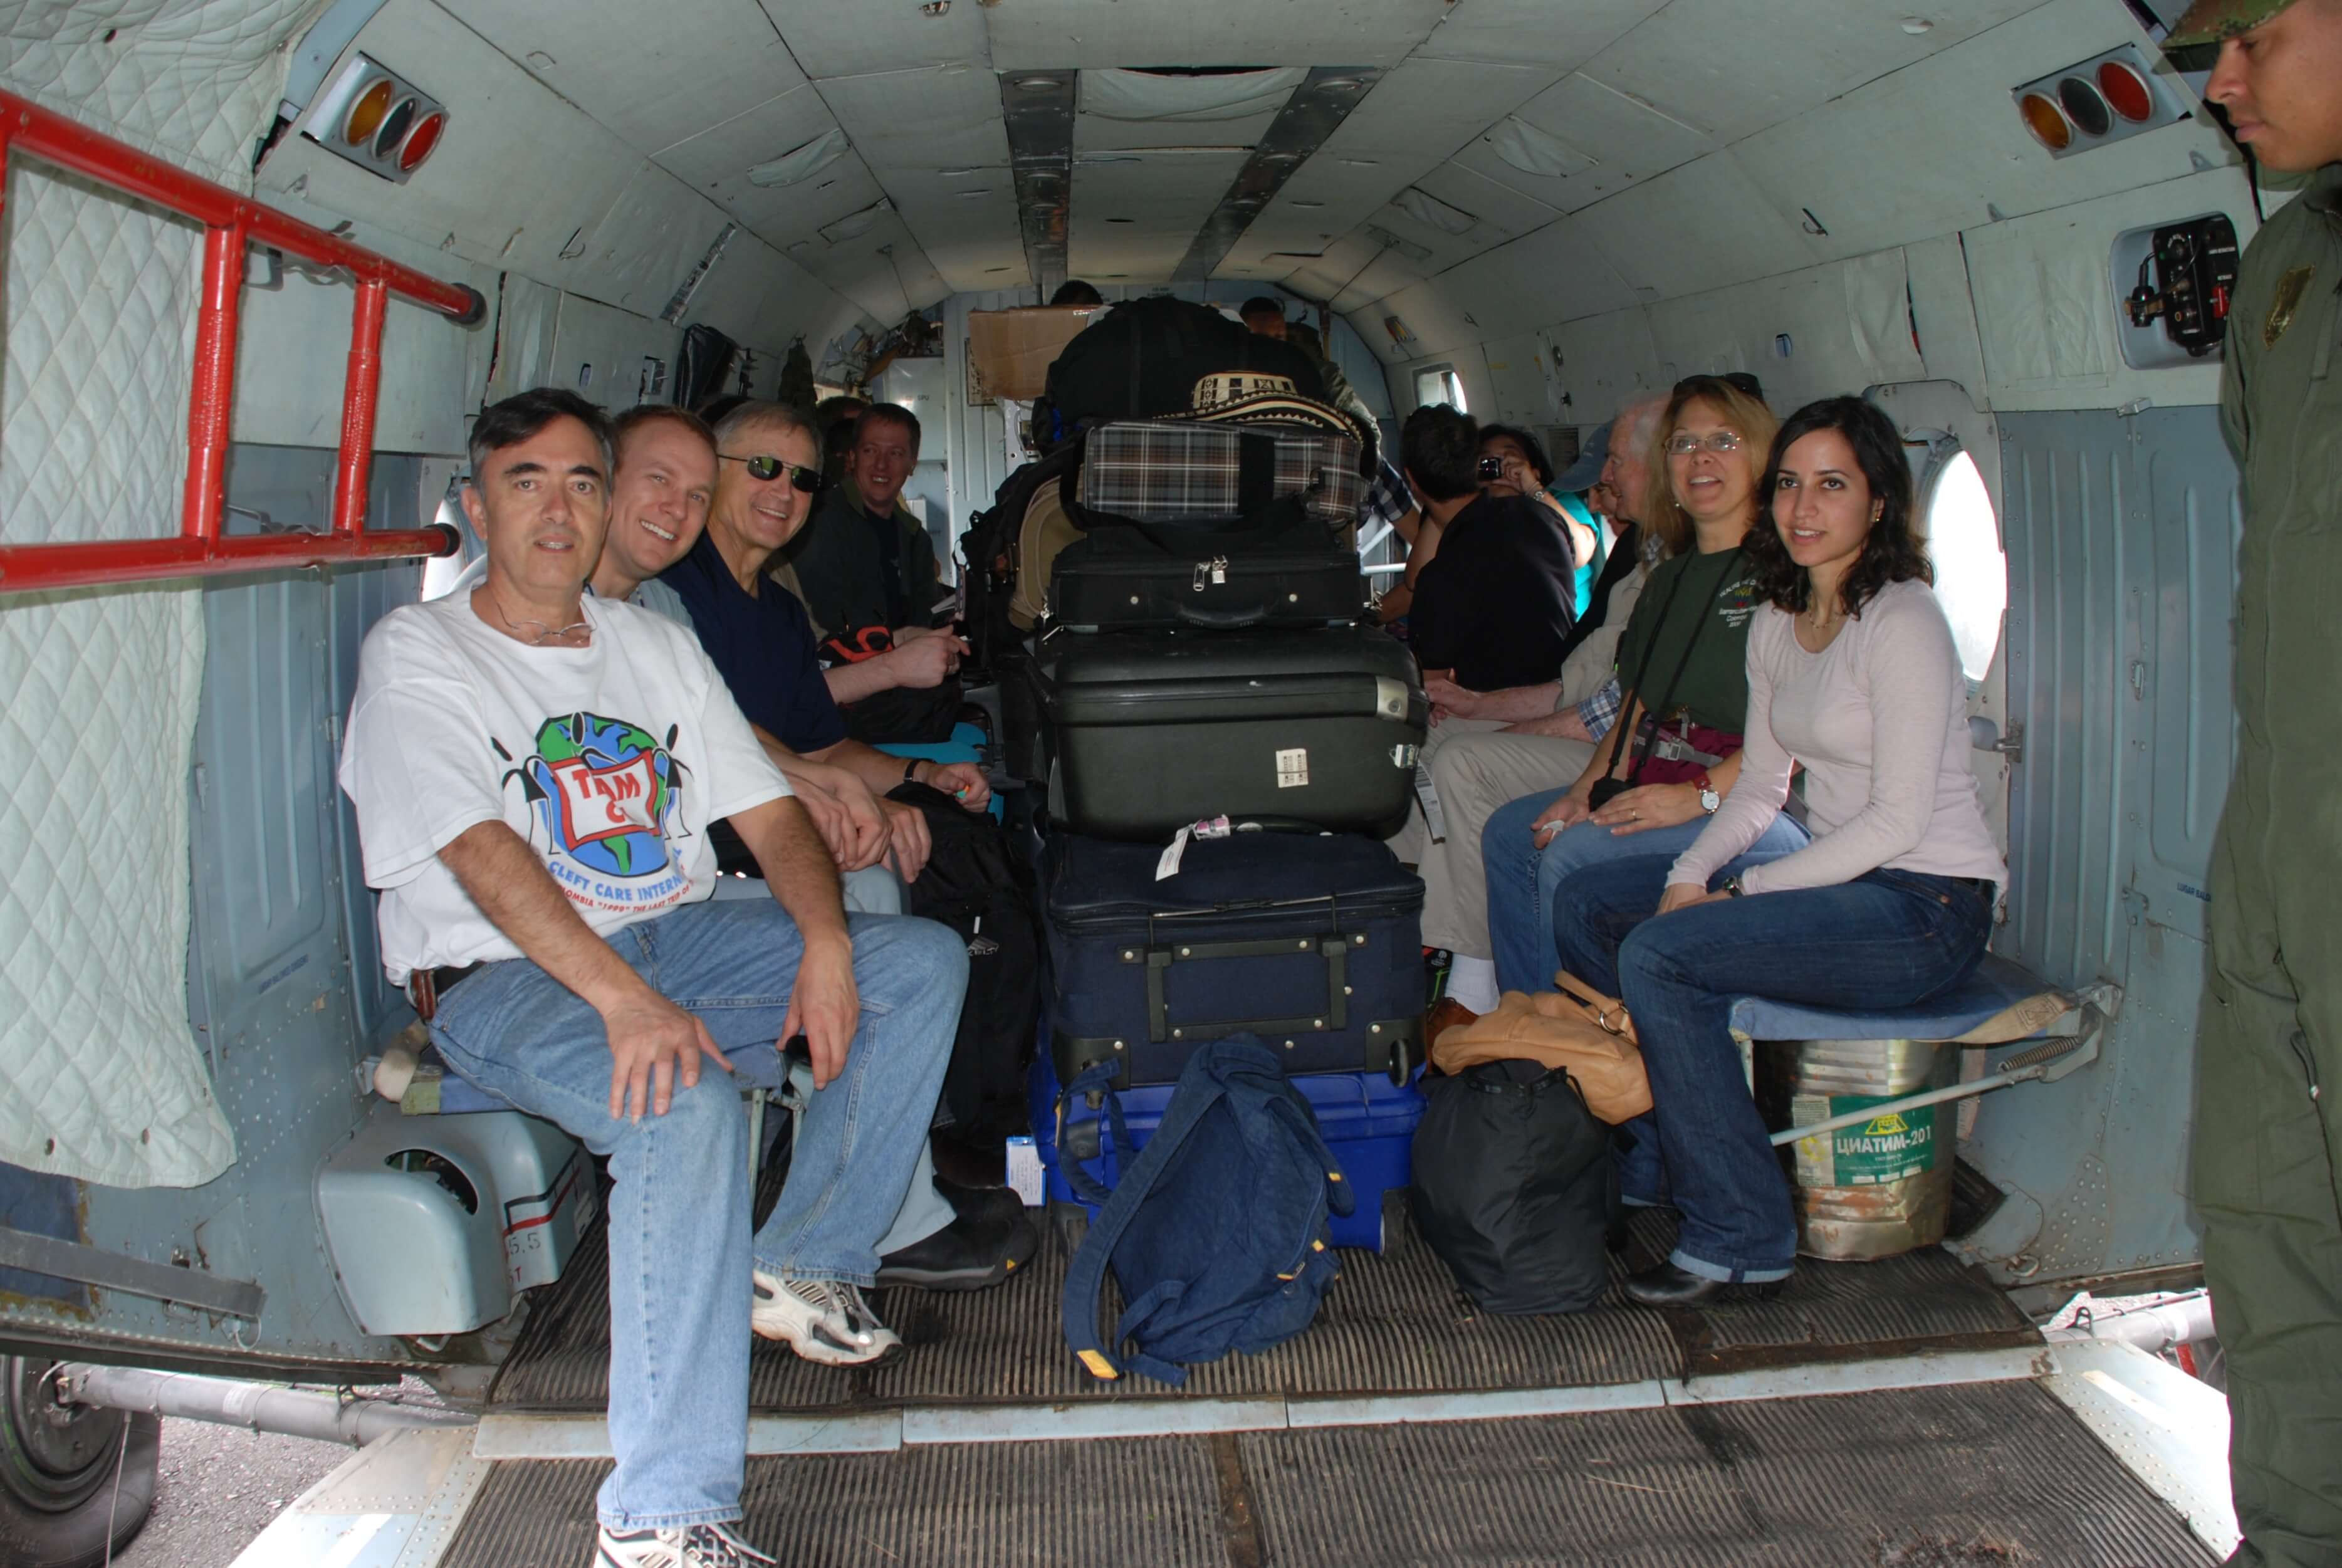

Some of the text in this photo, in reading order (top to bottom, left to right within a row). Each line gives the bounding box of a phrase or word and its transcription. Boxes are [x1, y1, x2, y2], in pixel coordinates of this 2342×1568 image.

[549, 861, 683, 901] CLEFT CARE INTERN
[1837, 1124, 1931, 1156] ЦИАТИМ-201
